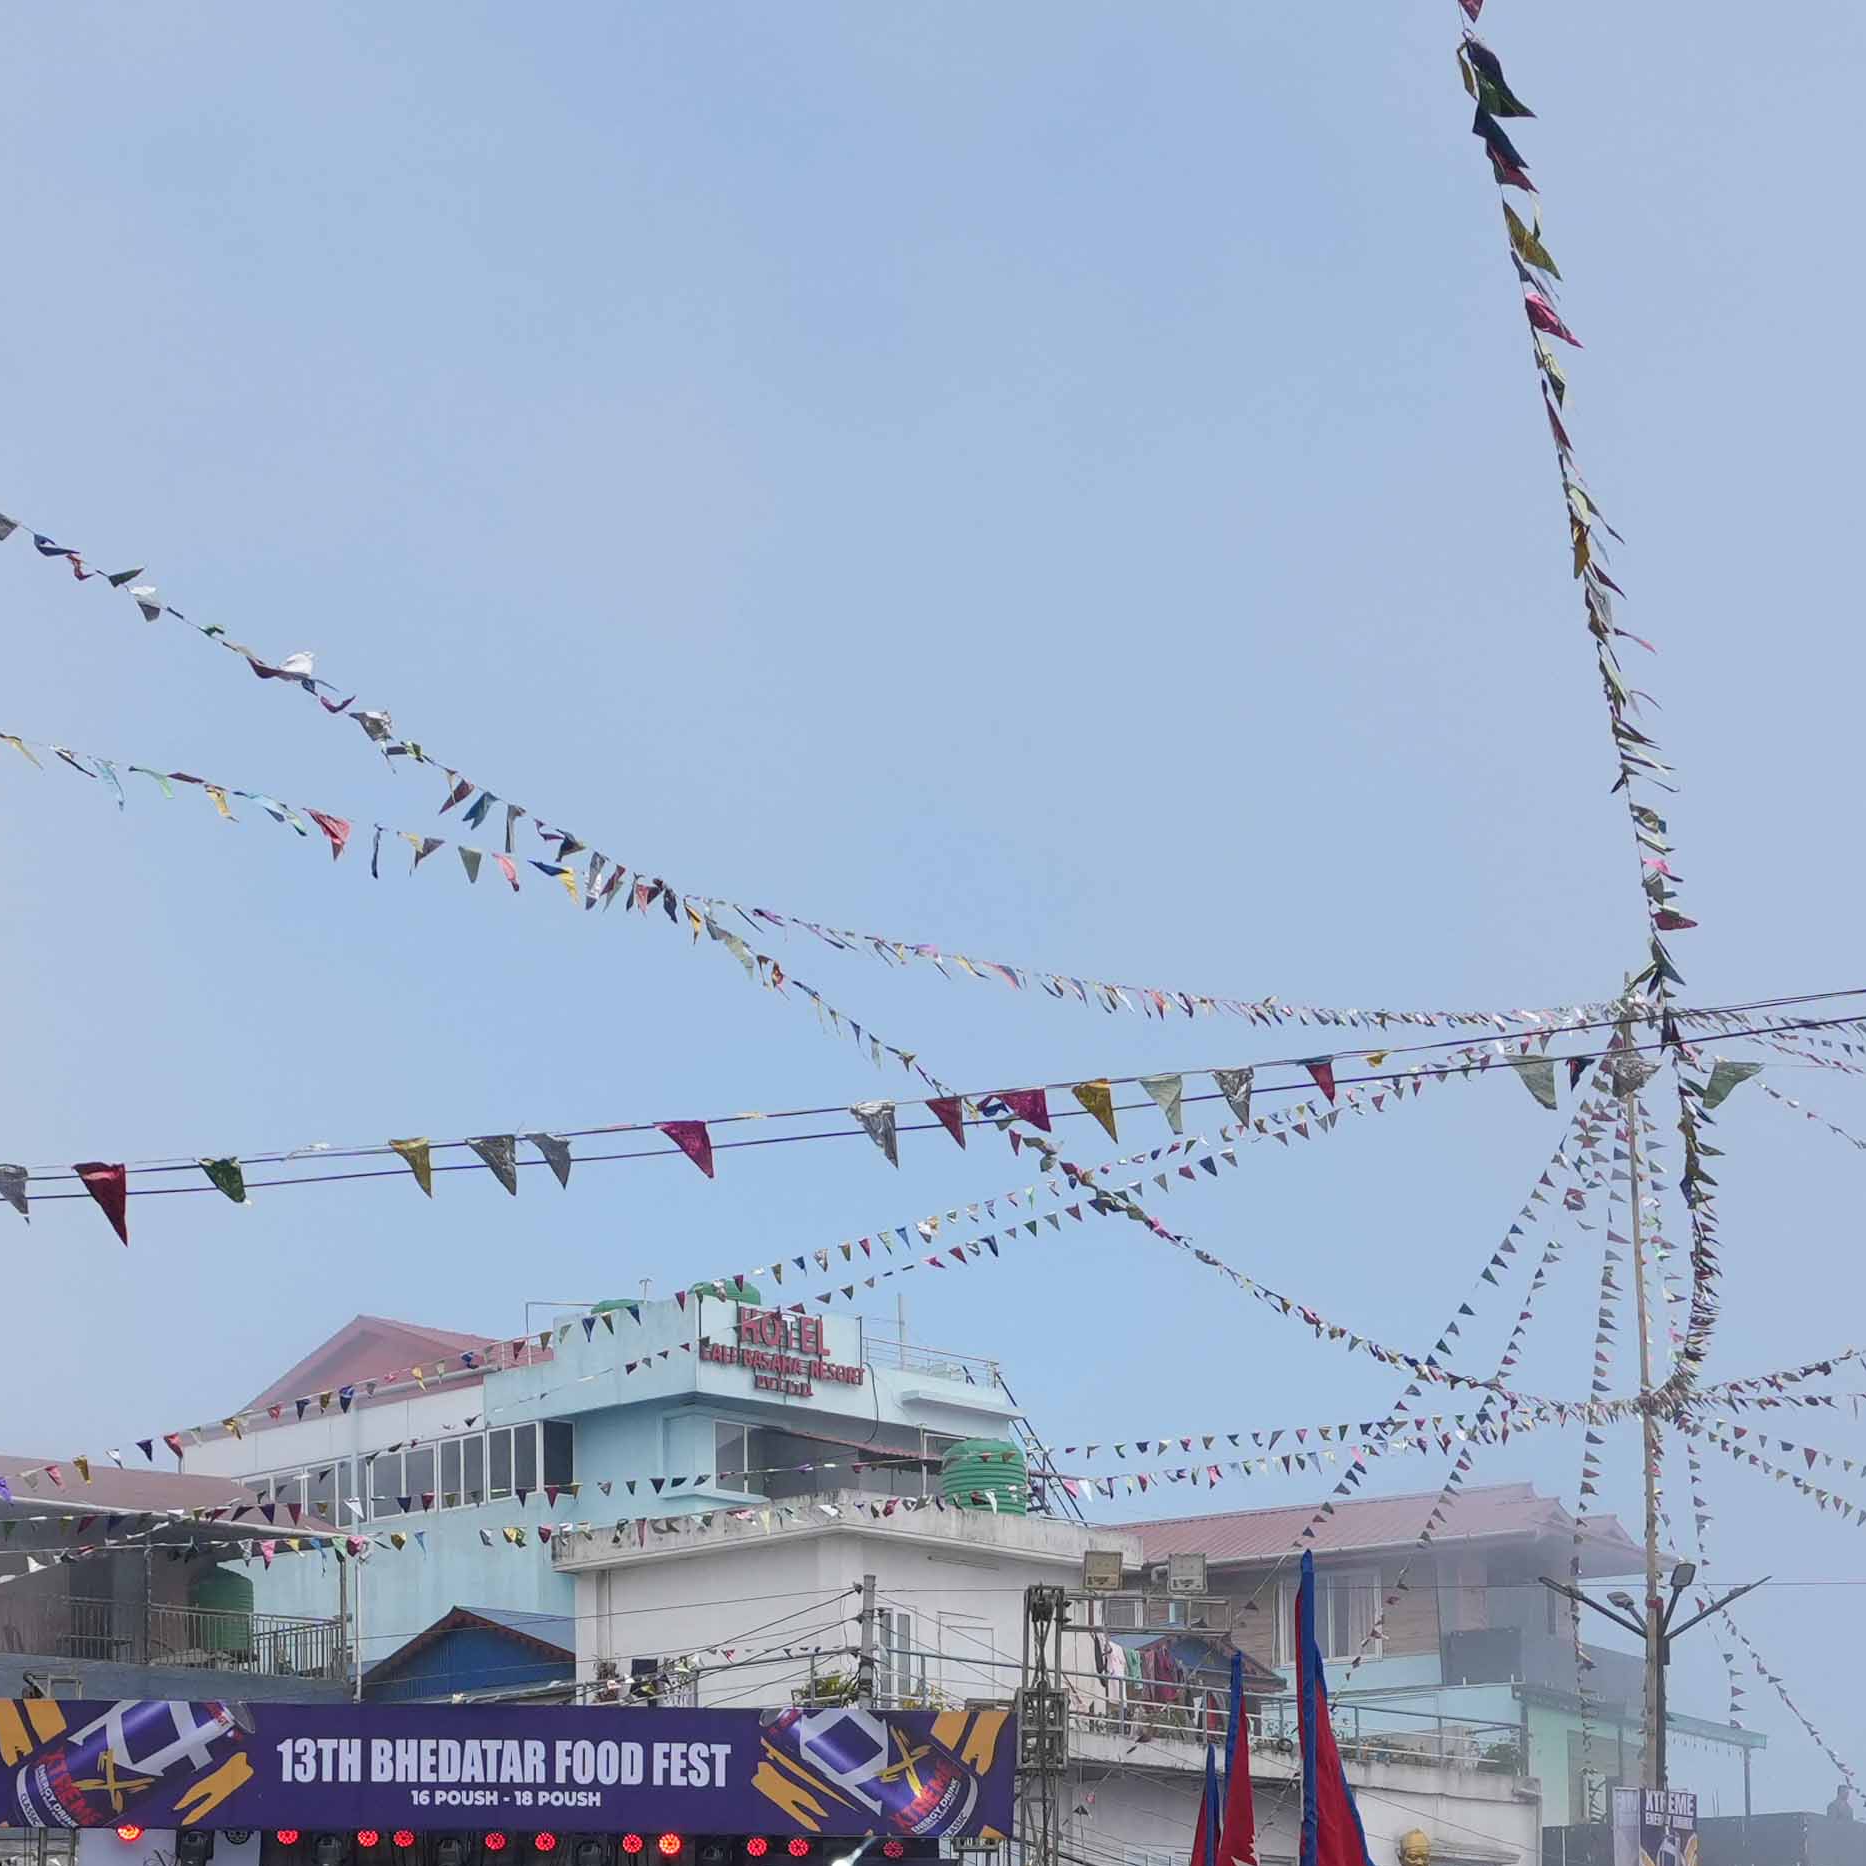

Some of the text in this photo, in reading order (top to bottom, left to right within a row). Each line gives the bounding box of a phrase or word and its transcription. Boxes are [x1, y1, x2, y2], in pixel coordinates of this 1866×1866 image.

[740, 1306, 830, 1357] HOTEL
[810, 1360, 866, 1385] RESORT
[276, 1738, 732, 1788] 13TH BHEDATAR FOOD FEST
[411, 1790, 430, 1806] 16
[434, 1790, 498, 1806] POUSH
[514, 1790, 533, 1806] 18
[537, 1791, 602, 1807] POUSH
